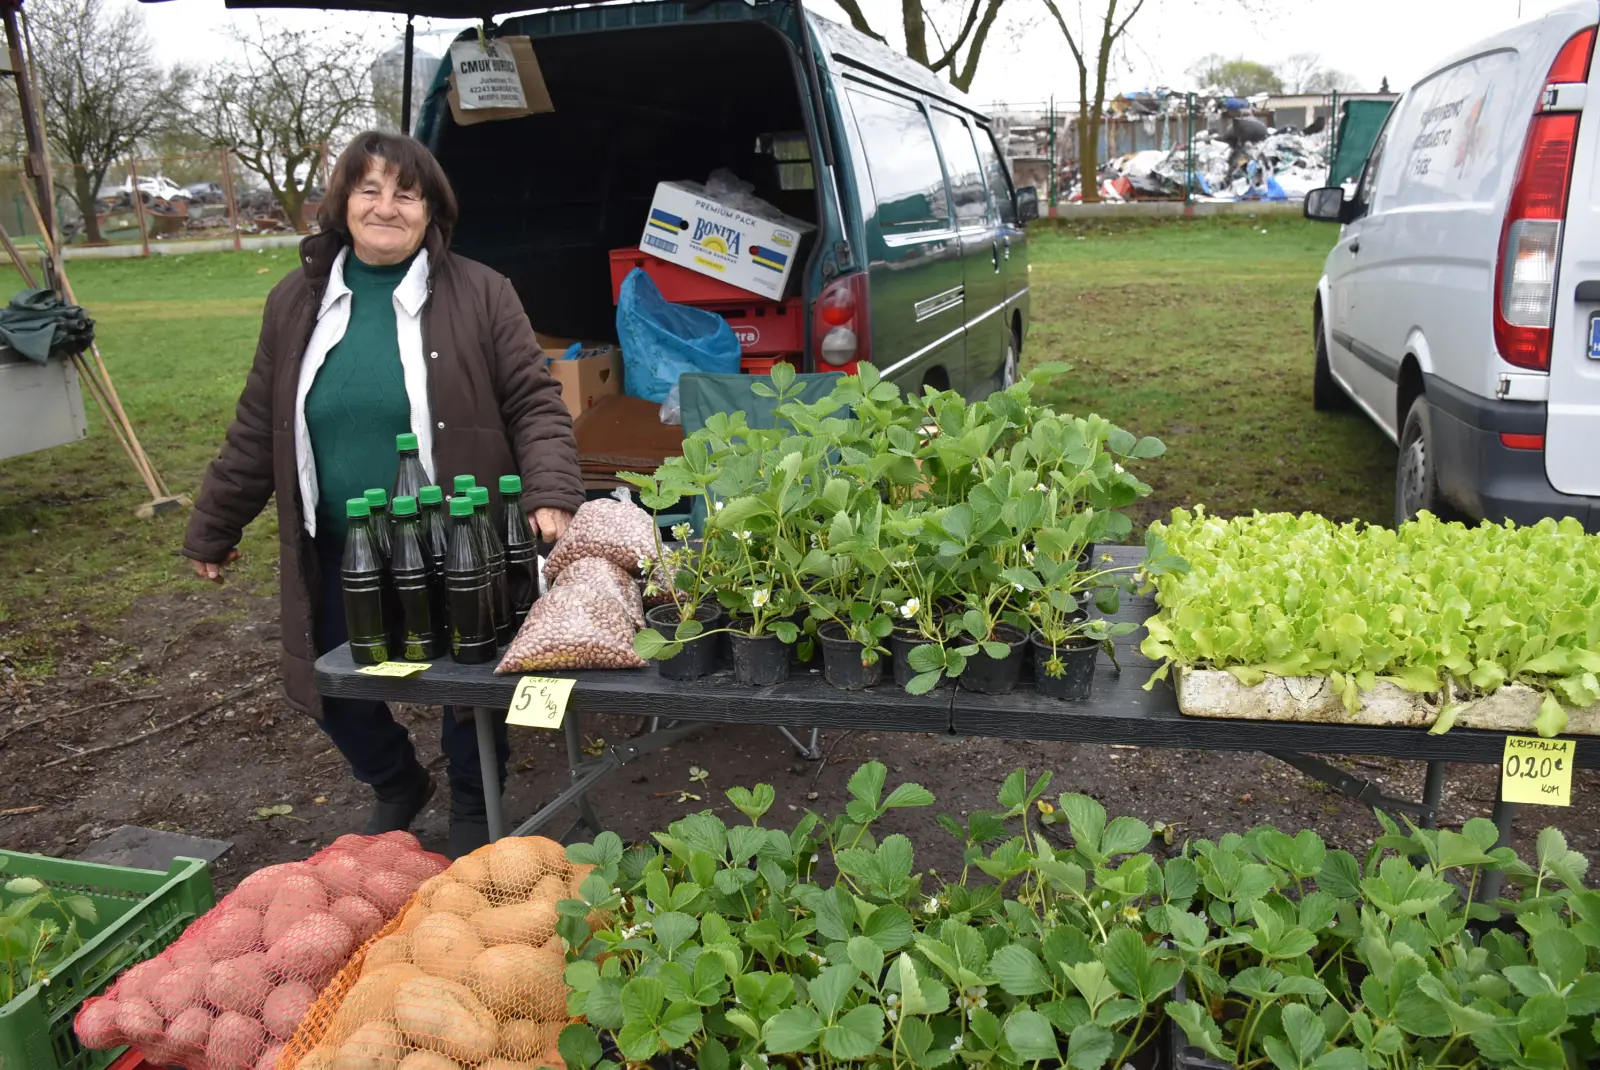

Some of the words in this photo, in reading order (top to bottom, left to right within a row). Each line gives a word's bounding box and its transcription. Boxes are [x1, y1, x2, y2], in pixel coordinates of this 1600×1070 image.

[460, 59, 491, 74] CMUK
[695, 200, 733, 219] PREMIUM
[735, 213, 757, 227] PACK
[692, 217, 741, 255] BONITA
[515, 685, 537, 711] 5
[1509, 739, 1567, 753] KRISTALKA
[1541, 784, 1560, 796] KOM
